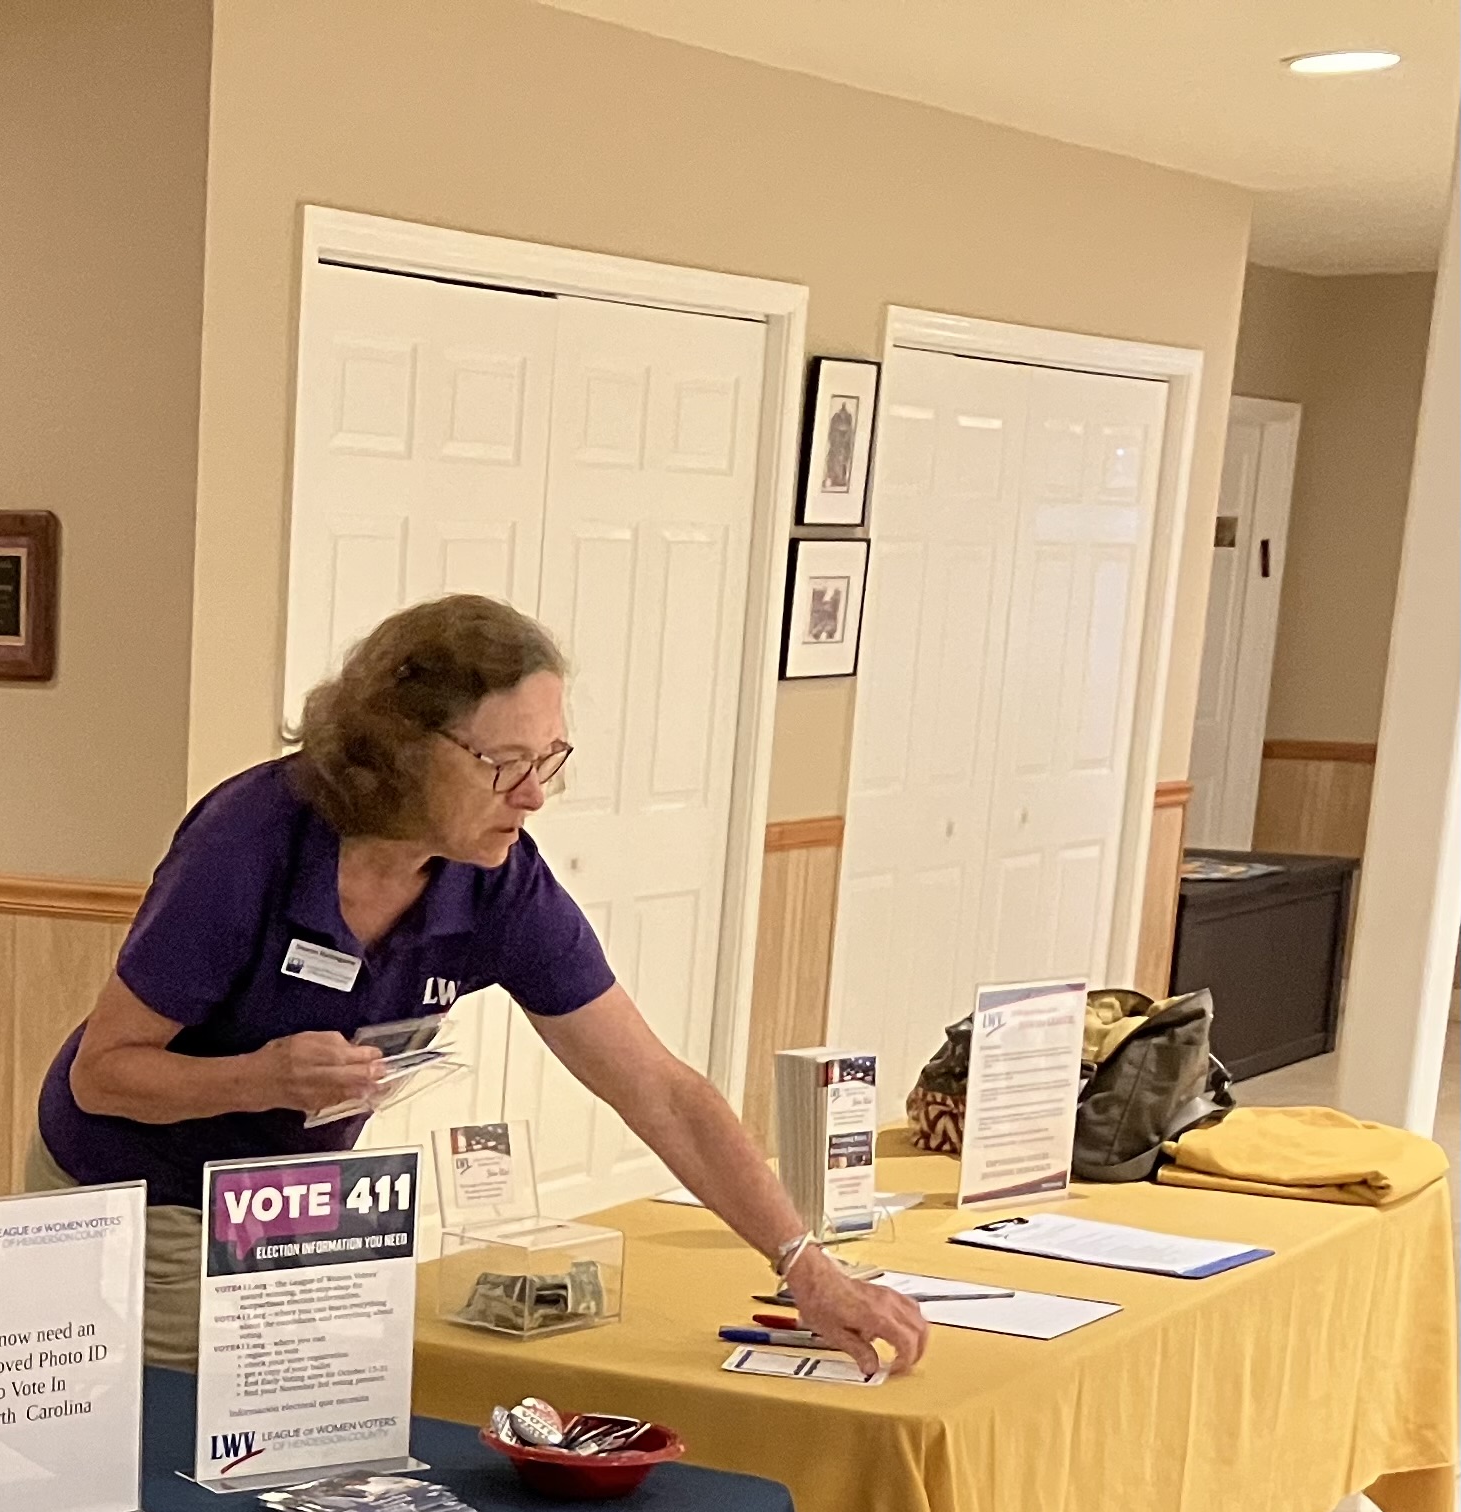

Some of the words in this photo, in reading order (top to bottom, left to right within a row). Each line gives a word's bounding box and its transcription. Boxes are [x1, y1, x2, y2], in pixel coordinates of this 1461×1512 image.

[224, 1183, 332, 1224] VOTE
[346, 1173, 411, 1214] 411
[44, 1220, 82, 1233] WOMEN
[84, 1216, 122, 1229] VOTERS
[16, 1232, 75, 1246] HENDERSON
[256, 1243, 299, 1260] ELECTION
[301, 1237, 362, 1255] INFORMATION
[364, 1235, 382, 1248] YOU
[384, 1232, 408, 1247] NEED
[36, 1321, 73, 1343] need
[77, 1322, 95, 1338] an
[39, 1349, 83, 1368] Photo
[88, 1344, 108, 1362] ID
[11, 1380, 46, 1397] Vote
[51, 1376, 66, 1393] In
[26, 1399, 92, 1422] Carolina
[211, 1430, 255, 1460] LWV
[261, 1428, 300, 1442] LEAGUE
[316, 1421, 357, 1434] WOMEN
[358, 1416, 397, 1429] VOTERS
